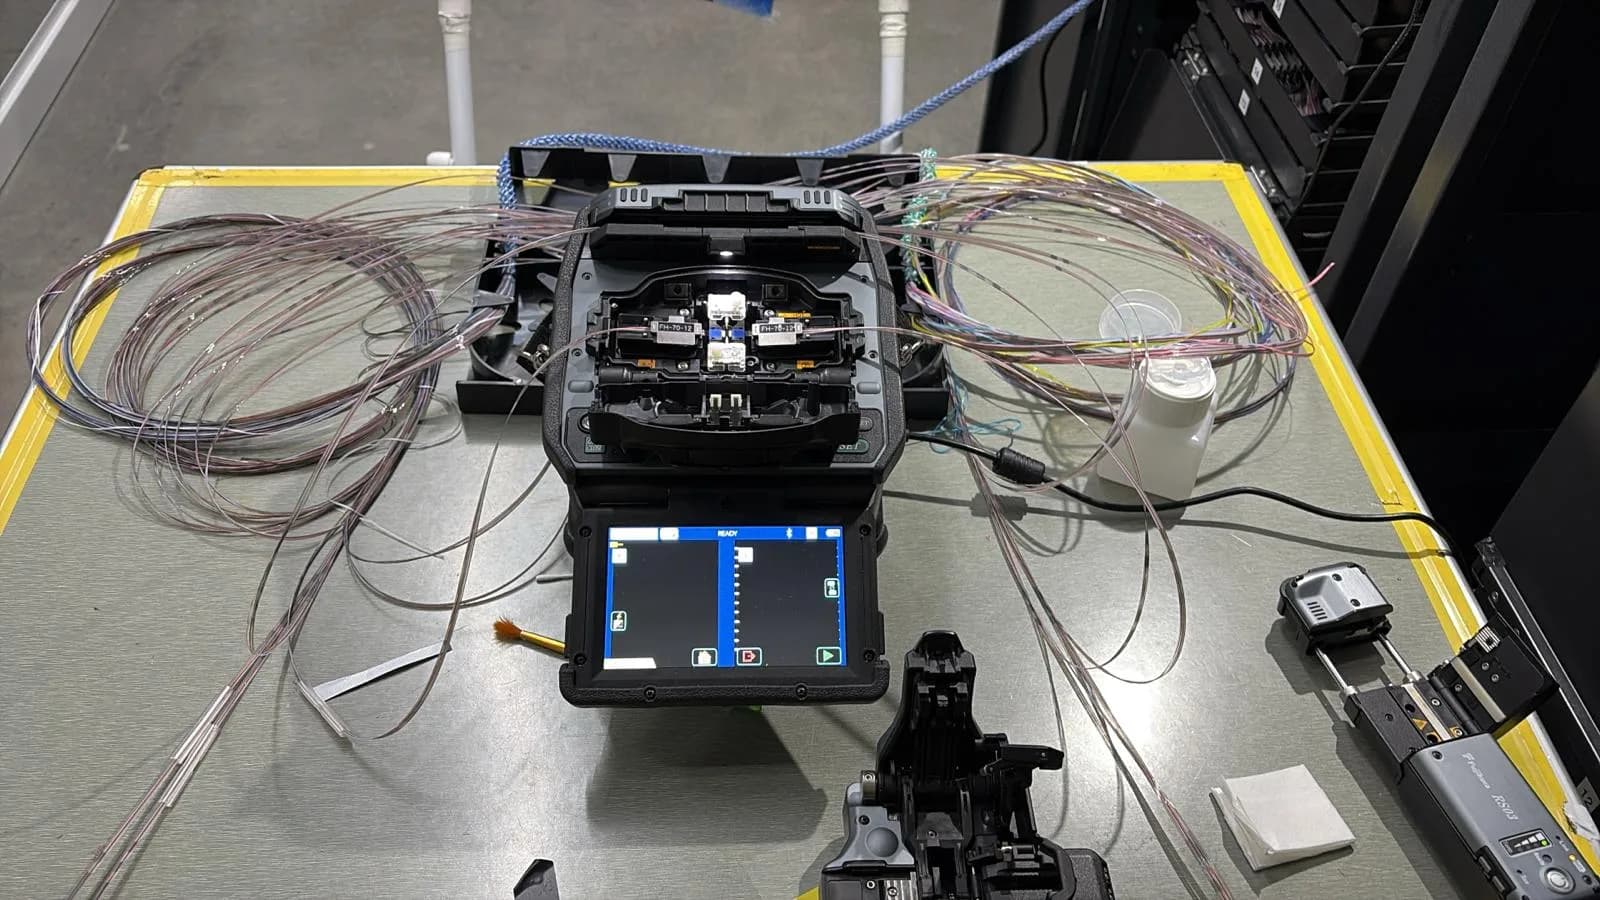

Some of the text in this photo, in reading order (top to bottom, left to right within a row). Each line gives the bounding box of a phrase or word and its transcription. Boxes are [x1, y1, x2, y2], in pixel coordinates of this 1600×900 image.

[659, 323, 692, 332] FH-70-12
[717, 529, 739, 537] READY
[1491, 794, 1519, 820] RS03
